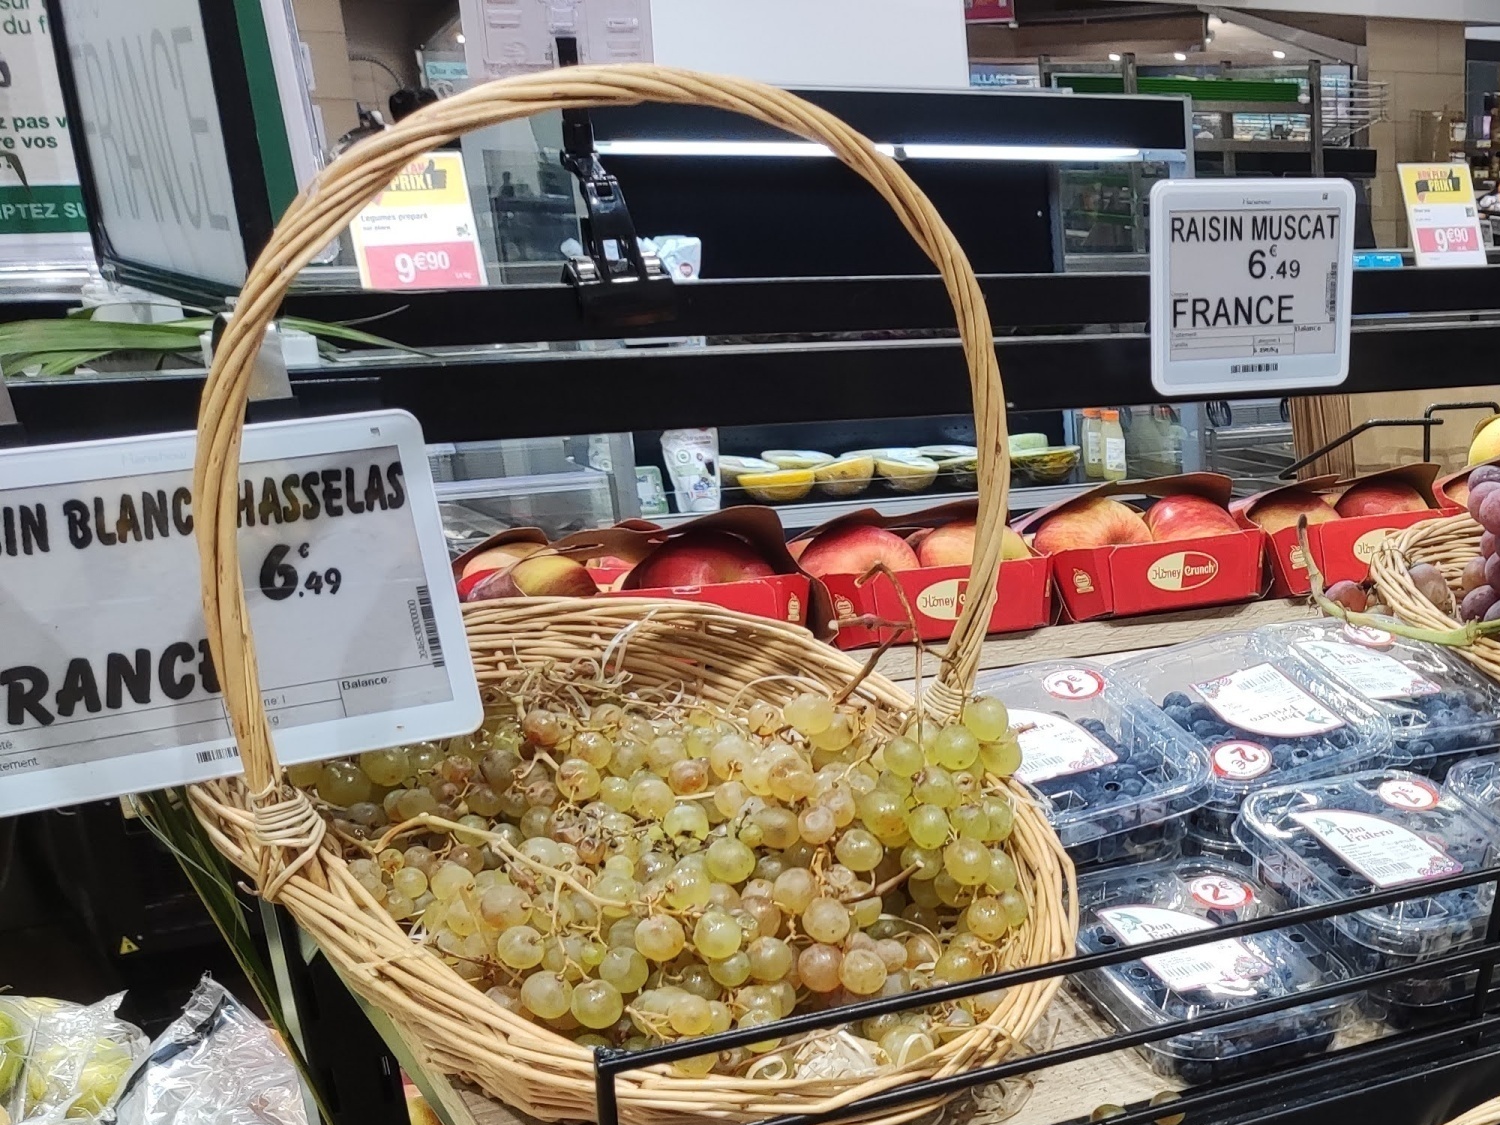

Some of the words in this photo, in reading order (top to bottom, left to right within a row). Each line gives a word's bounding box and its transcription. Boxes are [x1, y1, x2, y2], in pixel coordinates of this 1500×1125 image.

[3, 15, 32, 34] du
[13, 115, 50, 132] pas
[21, 136, 58, 149] vos
[0, 204, 59, 219] PTEZ
[1171, 216, 1243, 243] RAISIN
[1251, 214, 1340, 241] MUSCAT
[1434, 227, 1470, 252] 9€90
[394, 250, 451, 283] 9€90
[1172, 293, 1295, 329] FRANCE
[63, 486, 194, 550] BLANC
[237, 460, 406, 529] HASSELAS
[1183, 562, 1216, 577] Crunch
[1344, 828, 1394, 843] Frutero
[1140, 921, 1173, 934] Don
